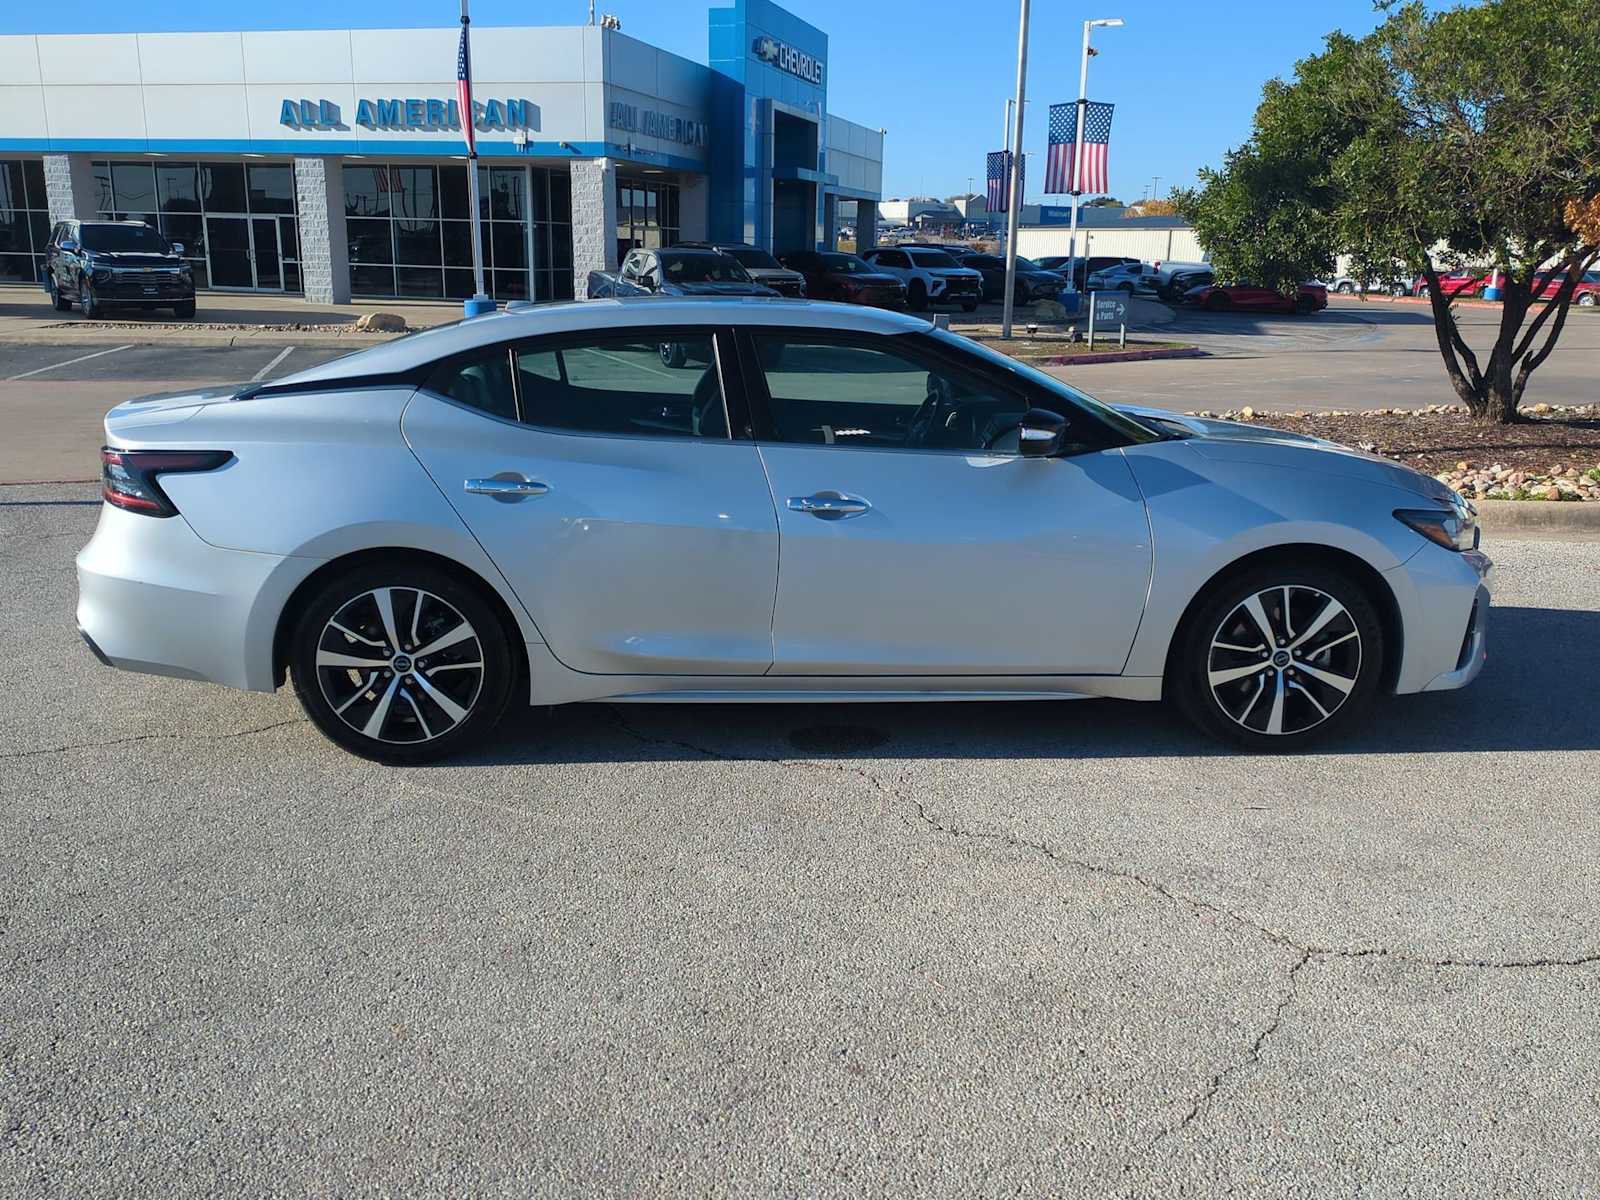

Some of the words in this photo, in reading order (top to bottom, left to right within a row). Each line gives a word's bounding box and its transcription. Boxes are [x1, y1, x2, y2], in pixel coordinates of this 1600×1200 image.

[779, 43, 824, 84] CHEVROLET
[280, 99, 338, 125] ALL
[611, 103, 639, 132] ALL
[1096, 300, 1116, 309] Service
[1101, 311, 1114, 320] Parts
